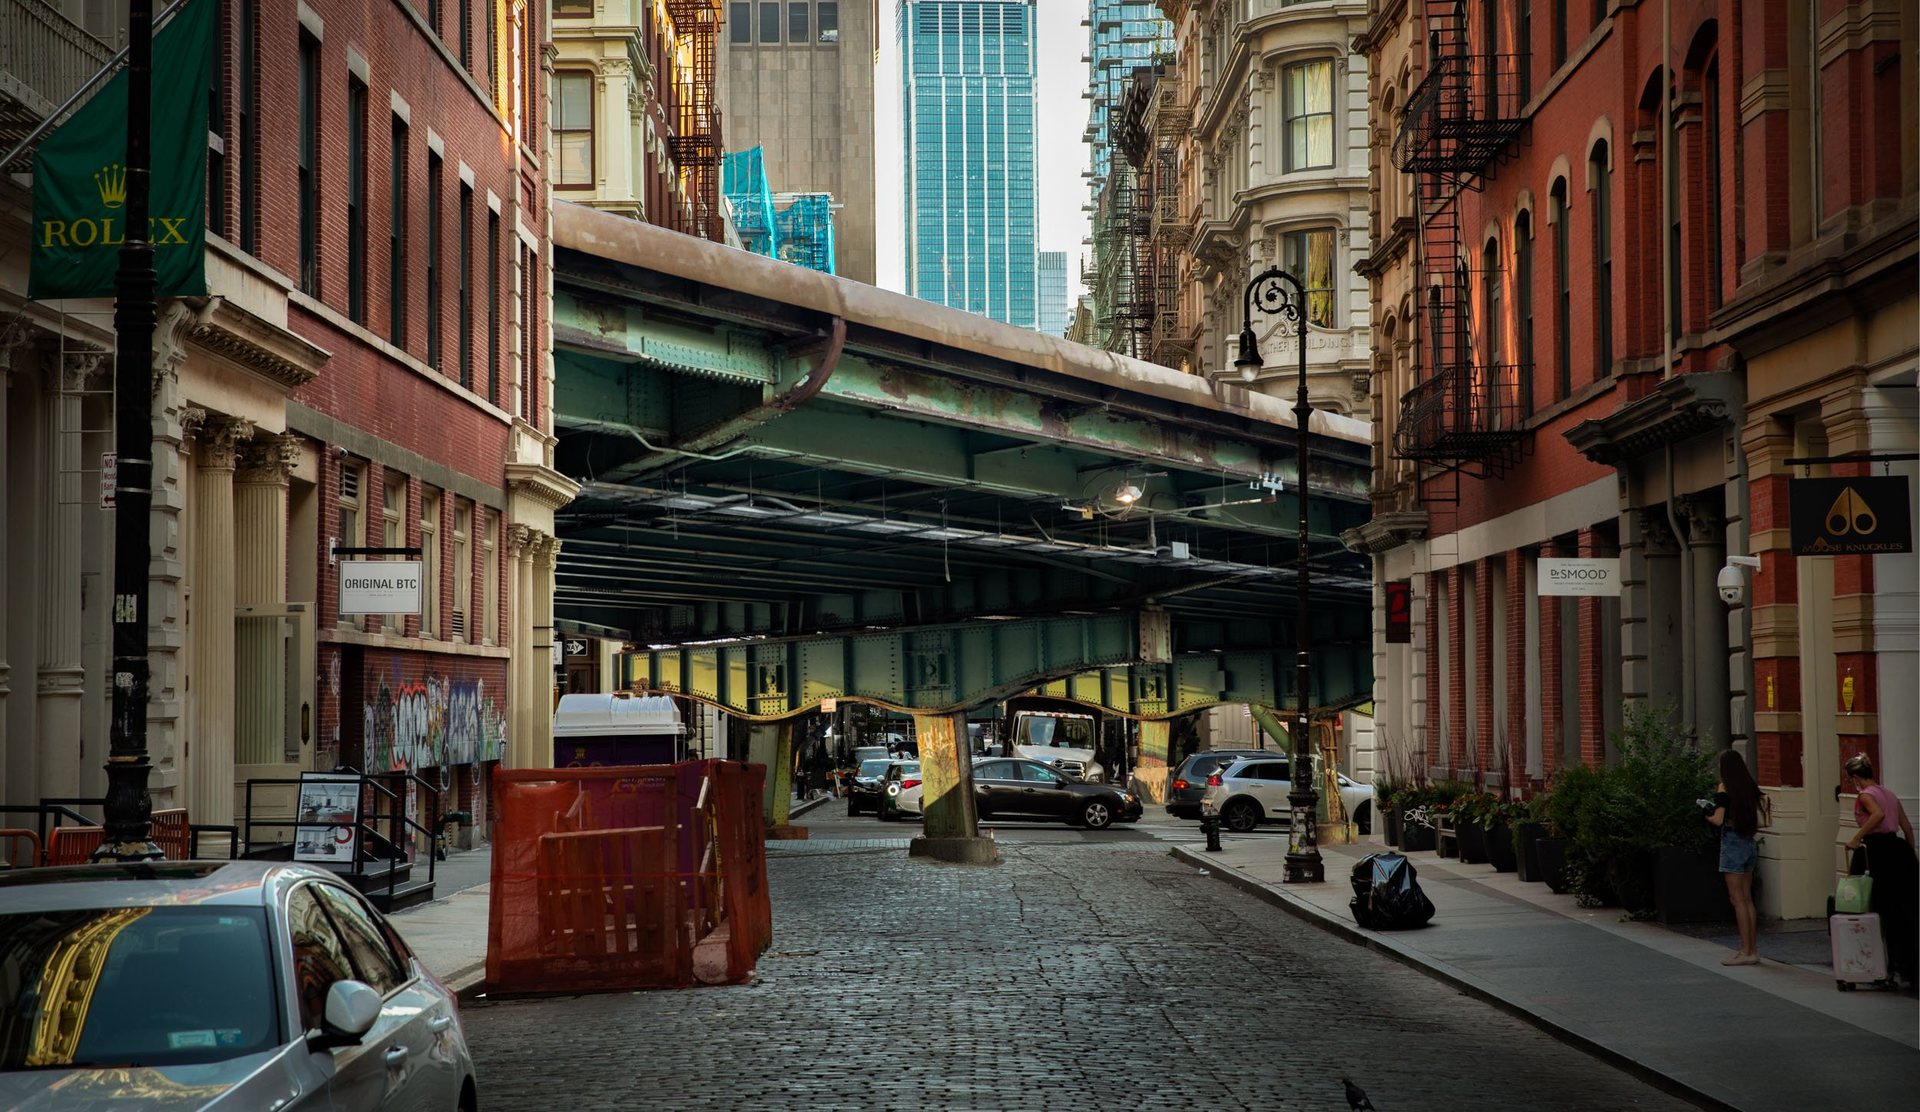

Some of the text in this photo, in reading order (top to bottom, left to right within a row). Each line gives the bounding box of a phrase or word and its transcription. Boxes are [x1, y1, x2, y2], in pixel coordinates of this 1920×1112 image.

[1295, 338, 1347, 350] BILDING
[105, 459, 113, 468] NO
[1802, 543, 1903, 552] MOOSE KNUCKLES
[344, 578, 417, 589] ORIGINAL BTC
